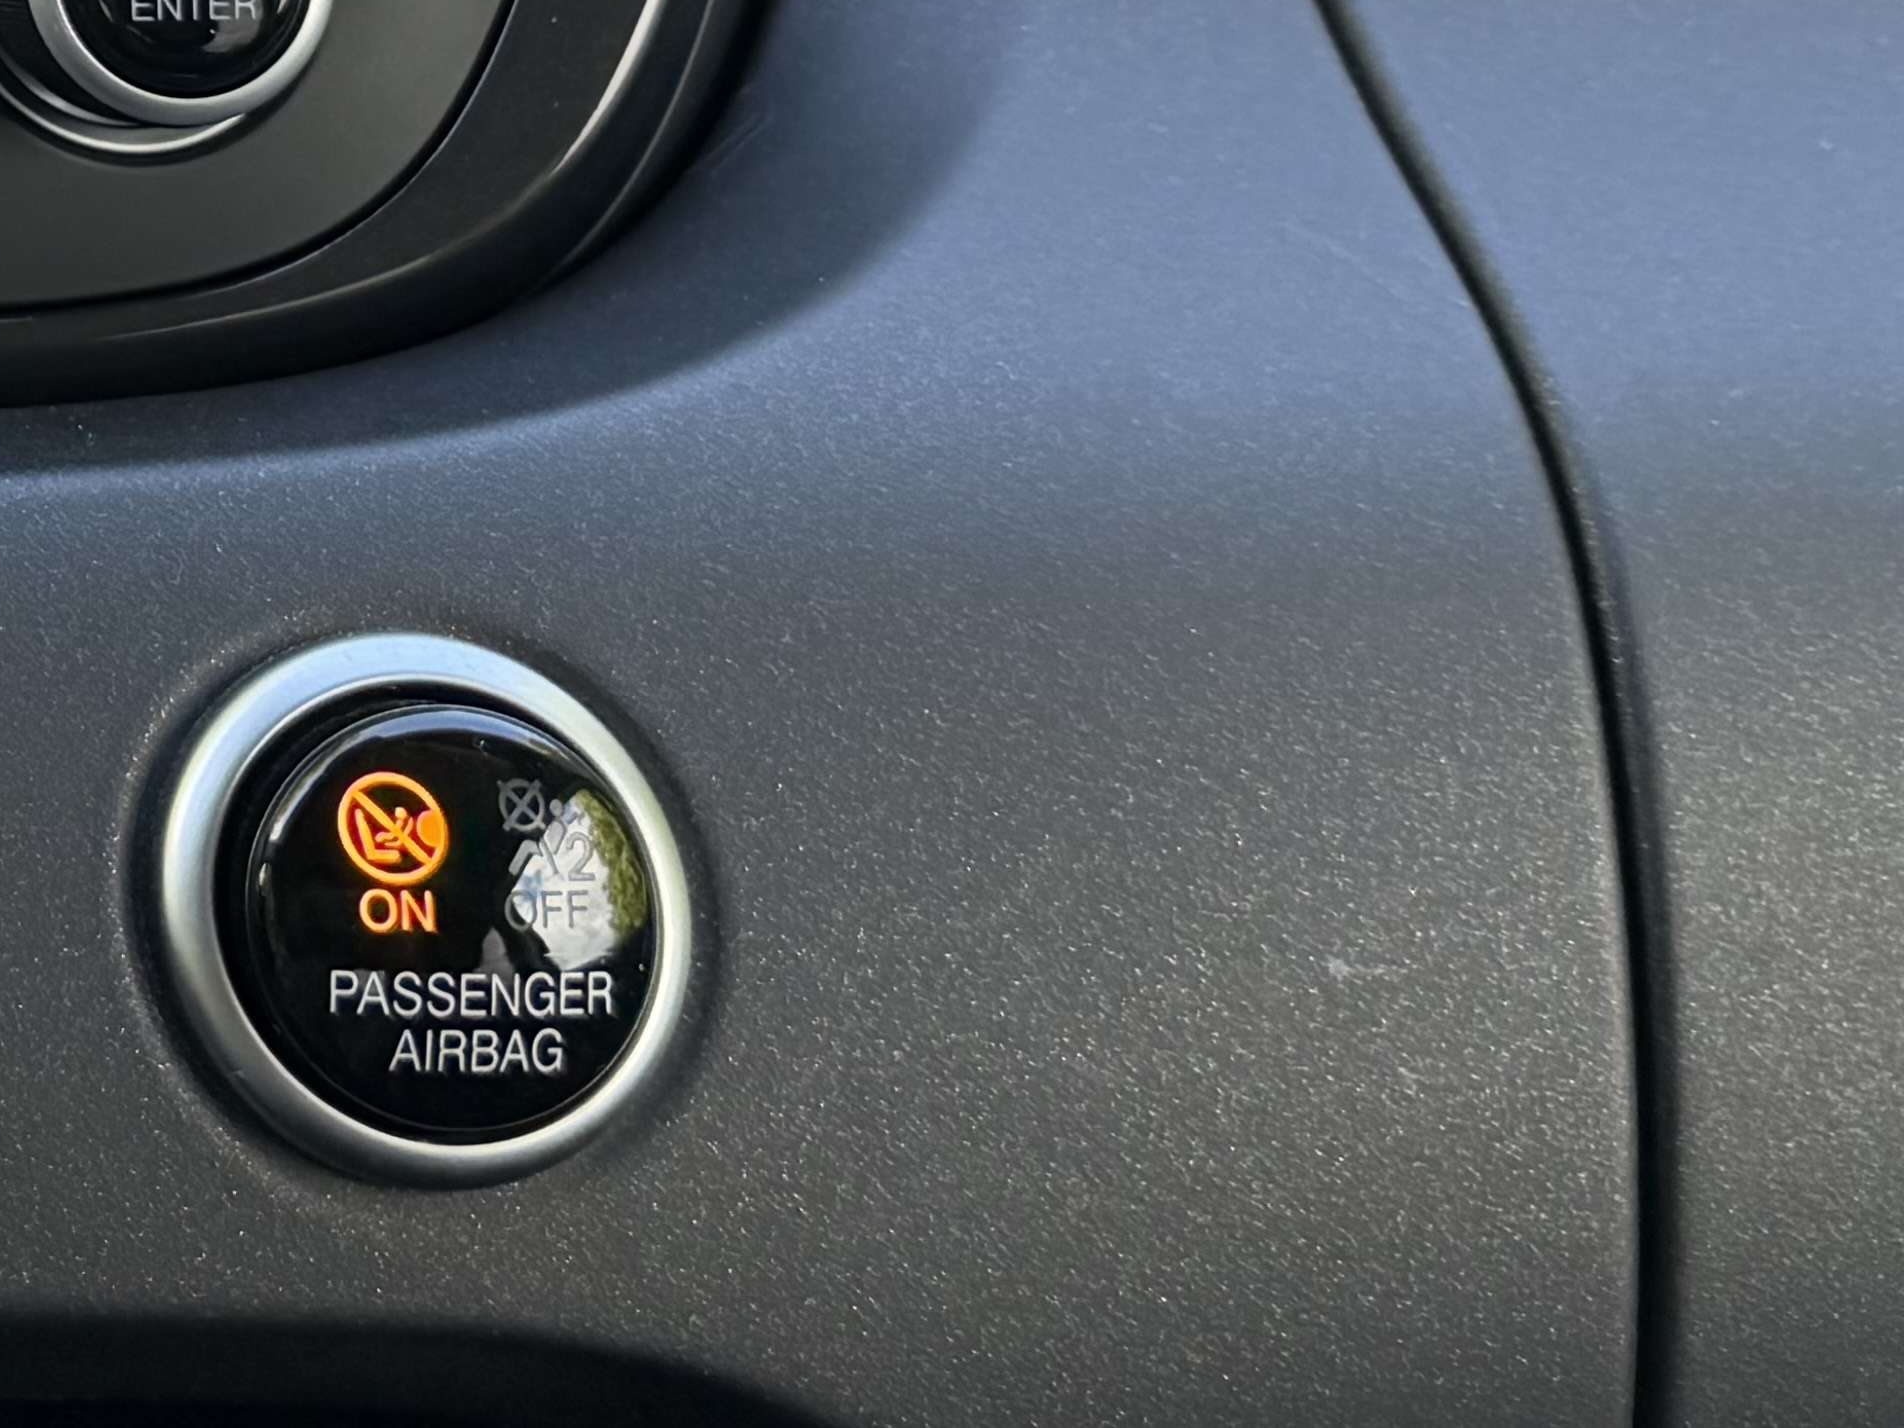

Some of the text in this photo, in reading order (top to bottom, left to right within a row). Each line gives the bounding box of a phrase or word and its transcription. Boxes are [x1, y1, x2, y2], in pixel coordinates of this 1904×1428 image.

[358, 888, 438, 933] ON
[504, 889, 590, 932] OFF
[328, 969, 615, 1017] PASSENGER
[388, 1028, 565, 1073] AIRBAG
